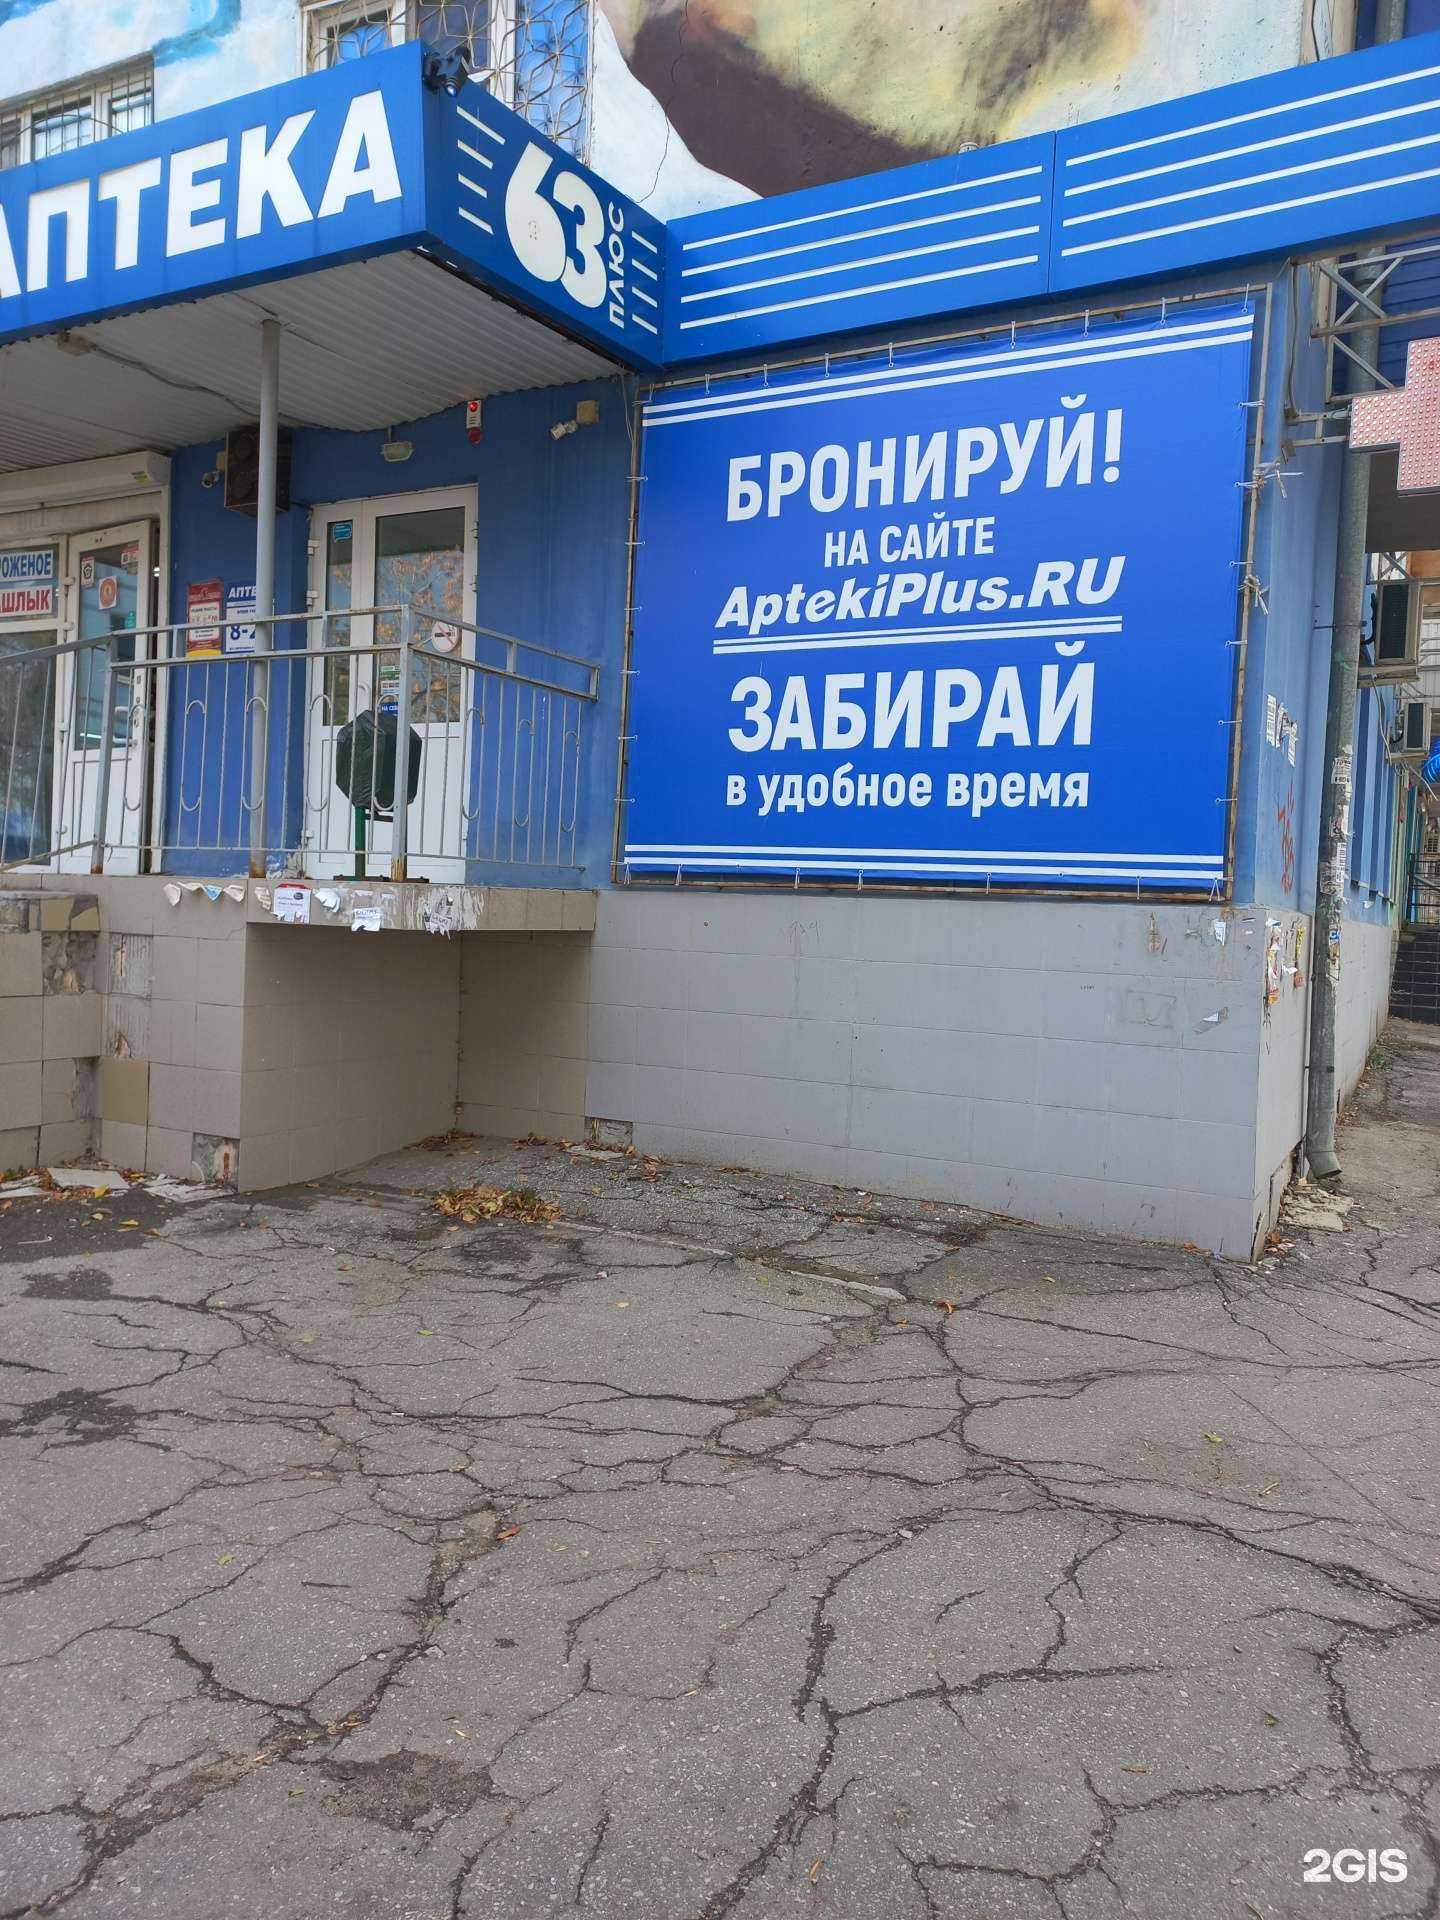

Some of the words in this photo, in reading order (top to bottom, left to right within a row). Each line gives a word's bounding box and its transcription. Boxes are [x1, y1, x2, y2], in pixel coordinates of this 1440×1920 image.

[505, 141, 607, 308] 63
[608, 201, 625, 328] ПЛЮС
[726, 393, 1123, 522] БРОНИРУЙ!
[0, 553, 52, 578] ОЖЕНОЕ
[823, 529, 869, 568] НА
[879, 511, 995, 563] САЙТЕ
[0, 590, 50, 614] ШЛЫК
[714, 555, 1127, 635] AptekiPlus.RU
[728, 640, 1095, 752] ЗАБИРАЙ
[726, 774, 747, 806] в
[757, 762, 932, 816] удобное
[946, 772, 1090, 818] время
